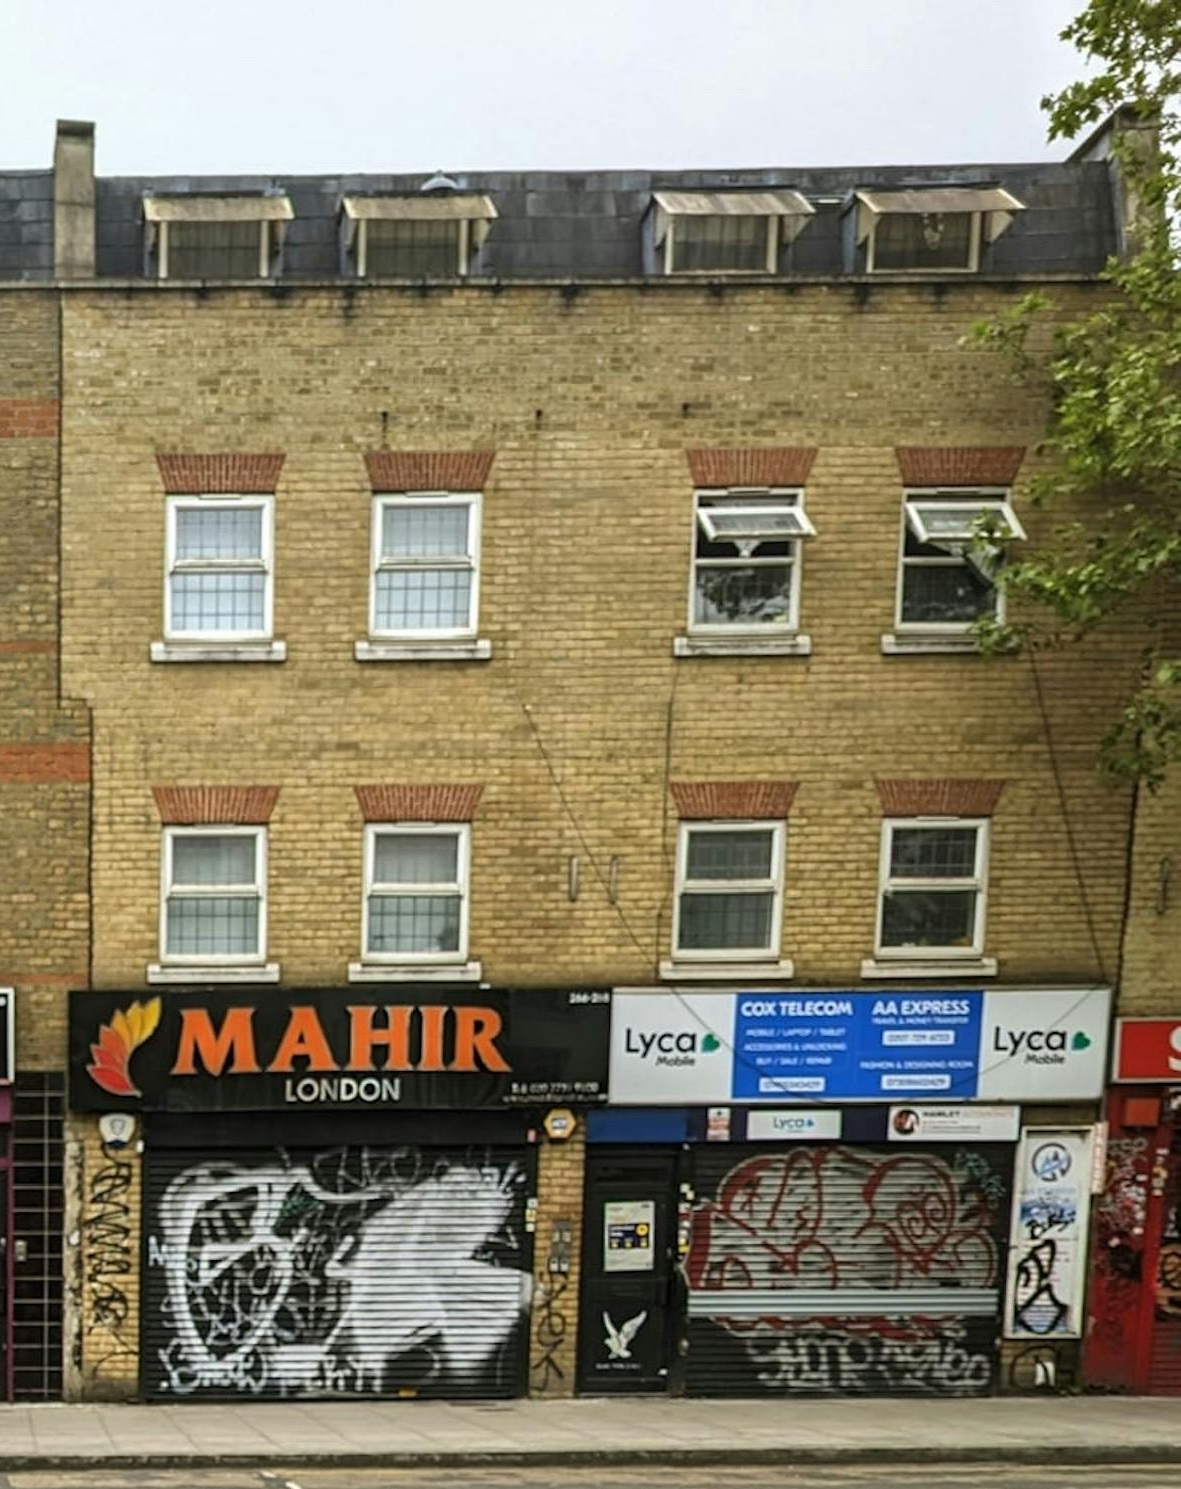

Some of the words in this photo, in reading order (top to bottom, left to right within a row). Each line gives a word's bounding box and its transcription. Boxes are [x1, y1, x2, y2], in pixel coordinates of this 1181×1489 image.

[740, 1001, 777, 1017] COX
[779, 1001, 854, 1017] TELECOM
[872, 1001, 898, 1015] AA
[900, 1001, 970, 1015] EXPRESS
[170, 1006, 512, 1075] MAHIR
[625, 1028, 697, 1059] Lyca
[994, 1026, 1067, 1057] Lyca
[655, 1054, 696, 1067] Mobile
[1024, 1053, 1065, 1065] Mobile
[284, 1077, 401, 1103] LONDON
[772, 1117, 805, 1130] Lyca
